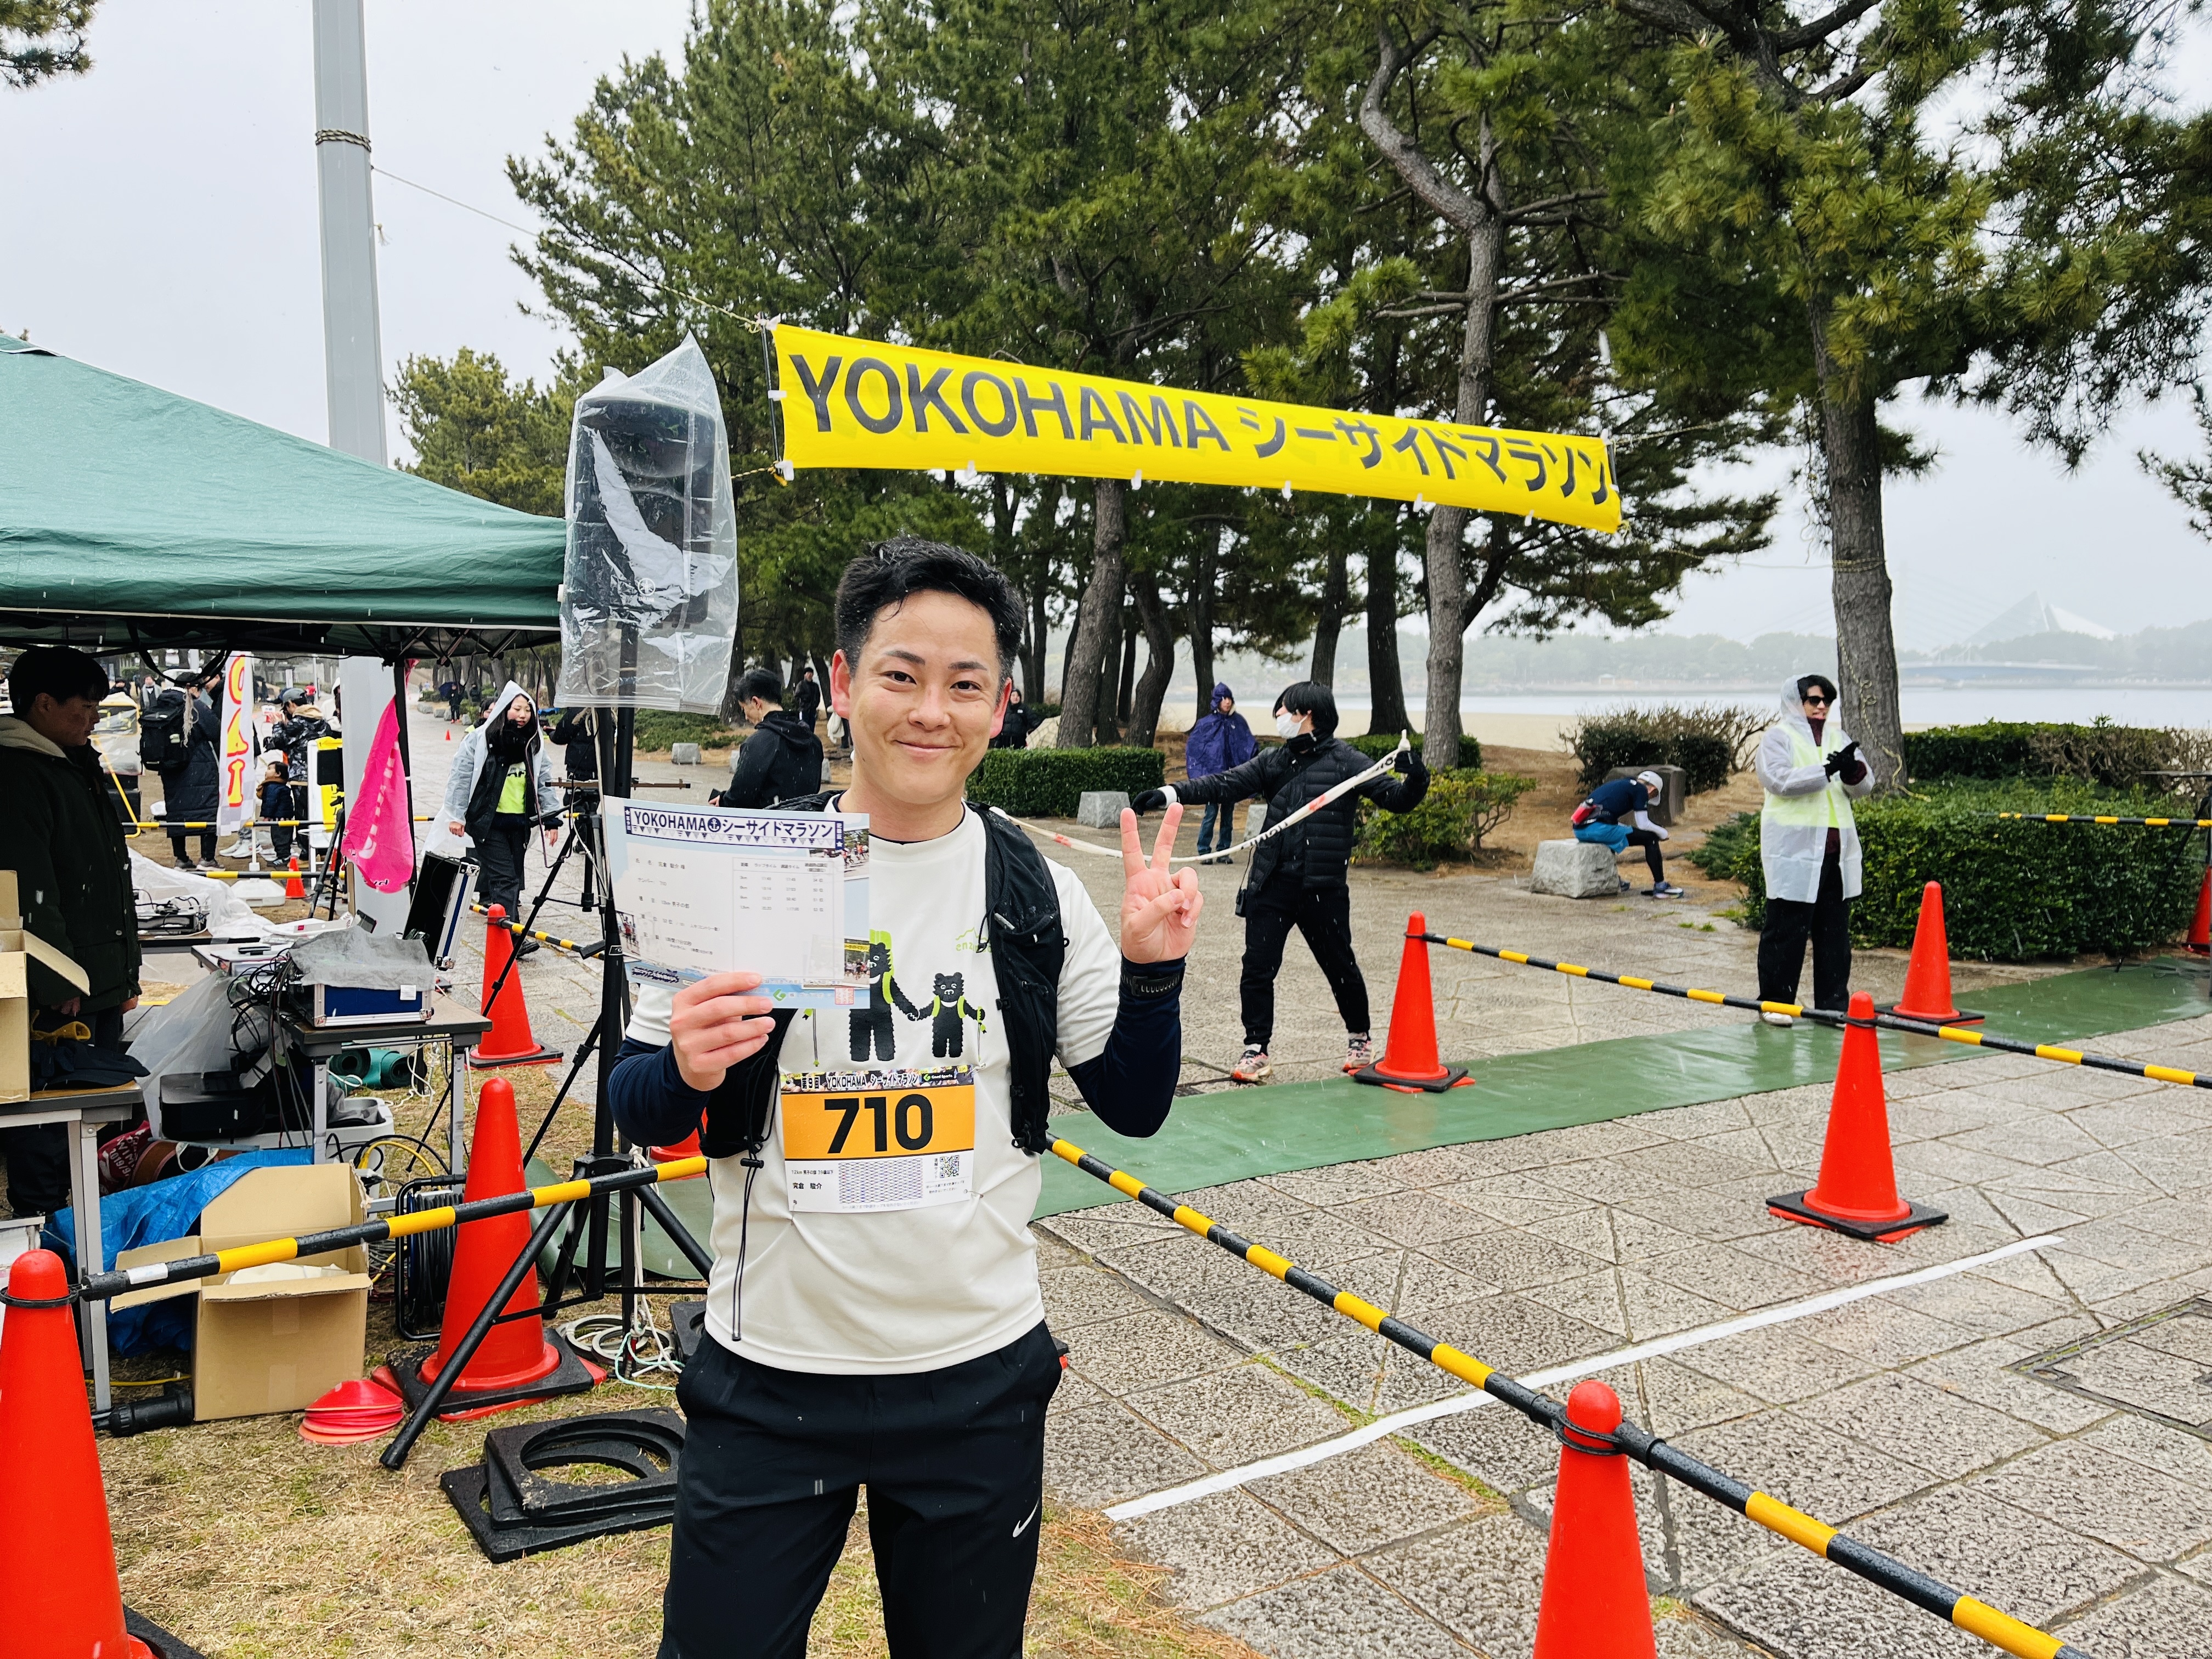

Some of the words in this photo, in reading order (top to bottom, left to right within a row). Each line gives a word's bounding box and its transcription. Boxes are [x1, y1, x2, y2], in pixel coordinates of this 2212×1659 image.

[789, 354, 1232, 452] YOKOHAMA
[1237, 406, 1608, 505] シーサイドマラソン
[634, 811, 707, 832] YOKOHAMA
[722, 819, 833, 838] シーサイドマラソン
[827, 1074, 867, 1089] YOKOHAMA
[870, 1073, 919, 1087] シーサイドマラソン
[825, 1093, 933, 1154] 710
